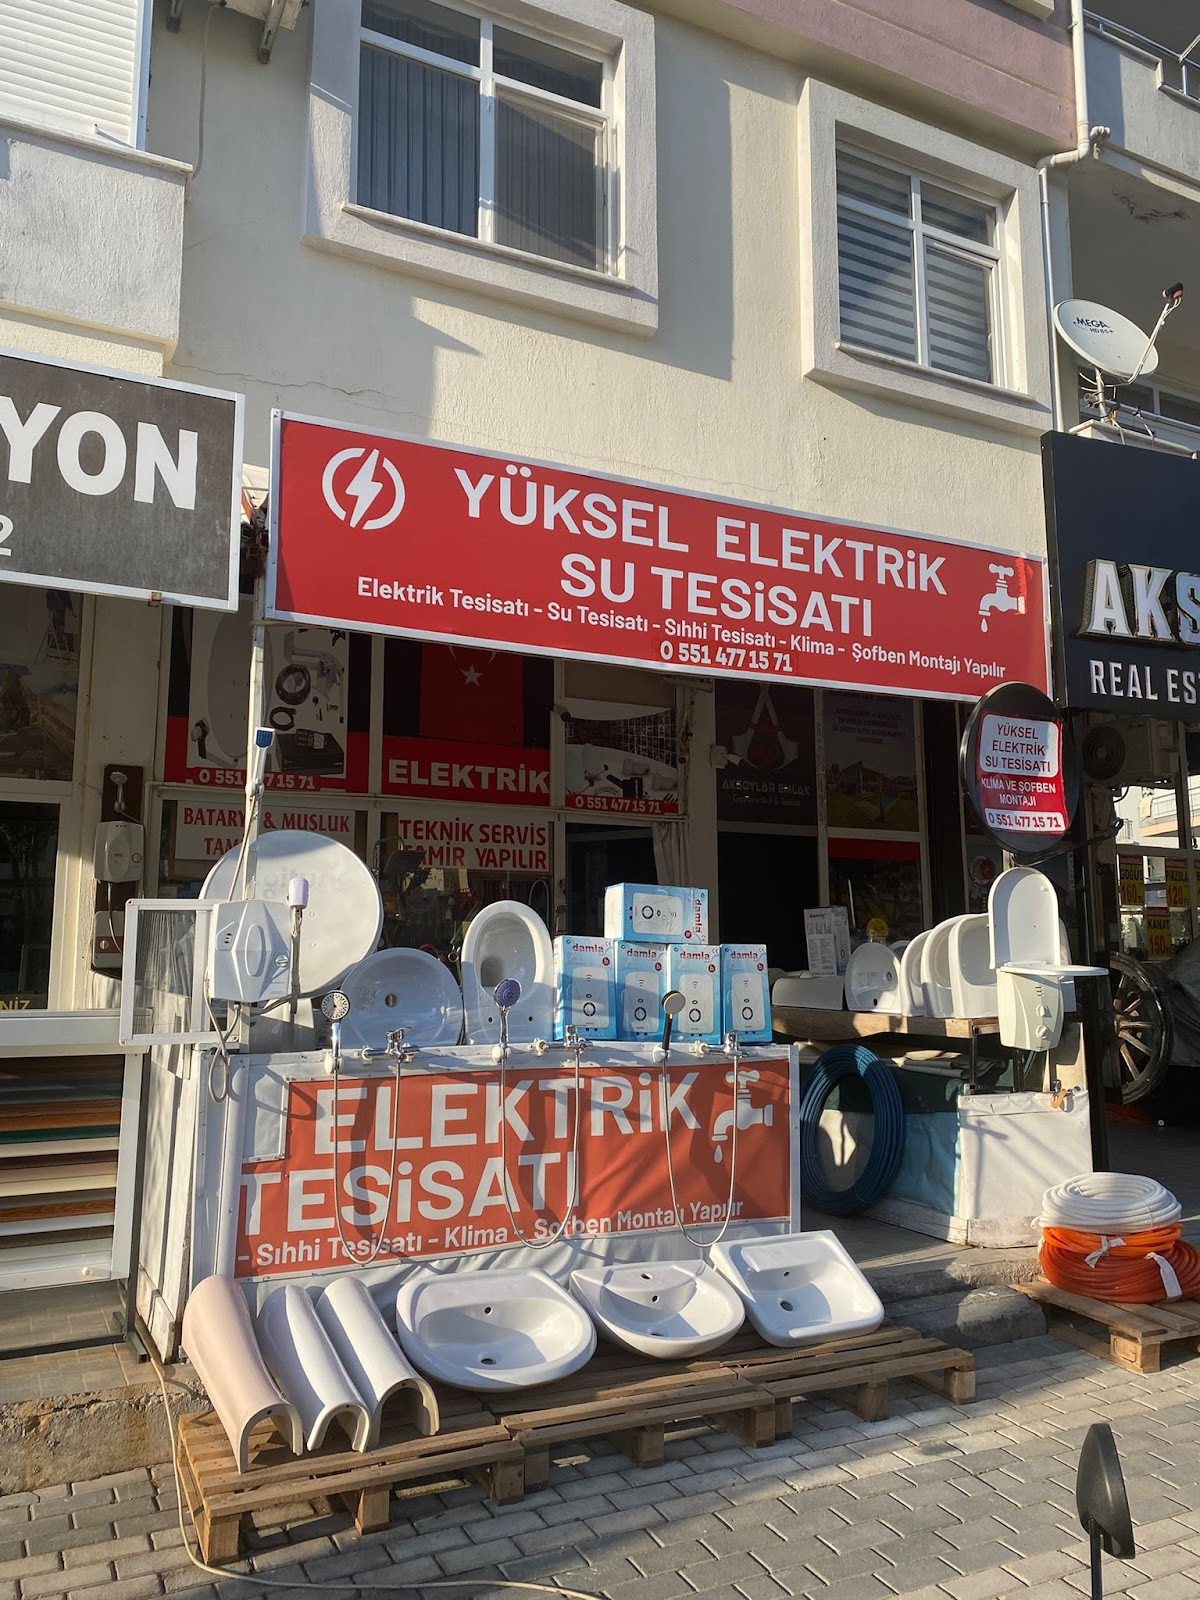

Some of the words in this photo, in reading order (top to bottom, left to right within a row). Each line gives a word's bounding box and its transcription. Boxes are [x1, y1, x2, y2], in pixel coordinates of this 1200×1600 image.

[1076, 317, 1110, 328] MEGA
[453, 464, 689, 553] YÜKSEL
[560, 553, 635, 603] SU
[1077, 559, 1200, 645] AKS
[357, 576, 443, 605] Elektrik
[449, 588, 528, 616] Tesisatı
[547, 601, 572, 623] Su
[576, 605, 648, 632] Tesisatı
[665, 618, 707, 640] Sıhhi
[713, 624, 775, 648] Tesisatı
[790, 635, 834, 655] Klima
[851, 643, 906, 664] Şofben
[909, 650, 960, 673] Montajı
[963, 658, 1006, 679] Yapılır
[678, 642, 711, 664] 551
[715, 645, 745, 667] 477
[749, 649, 770, 670] 15
[773, 652, 792, 672] 71
[1089, 659, 1158, 700] REAL
[1166, 669, 1200, 704] ES
[997, 721, 1039, 740] YÜKSEL
[992, 740, 1046, 756] ELEKTRİK
[985, 756, 999, 768] SU
[215, 770, 244, 785] 551
[276, 774, 295, 789] 15
[298, 775, 316, 790] 71
[388, 759, 550, 794] ELEKTRİK
[1006, 779, 1017, 791] VE
[1019, 779, 1057, 794] ŞOFBEN
[586, 796, 608, 810] 551
[611, 798, 632, 811] 477
[632, 800, 646, 812] 15
[649, 801, 661, 813] 71
[999, 793, 1037, 807] MONTAJI
[263, 812, 275, 829] &
[281, 813, 350, 832] MUSLUK
[996, 813, 1014, 827] 551
[1015, 815, 1031, 828] 477
[1033, 816, 1046, 828] 15
[1047, 816, 1061, 829] 71
[400, 817, 475, 843] TEKNİK
[478, 822, 547, 846] SERVİS
[475, 847, 547, 870] YAPILIR
[572, 943, 604, 954] damla
[626, 948, 657, 958] damla
[680, 950, 710, 960] damla
[730, 950, 758, 960] damla
[256, 1238, 320, 1266] Sıhhi
[445, 1224, 508, 1249] Klima
